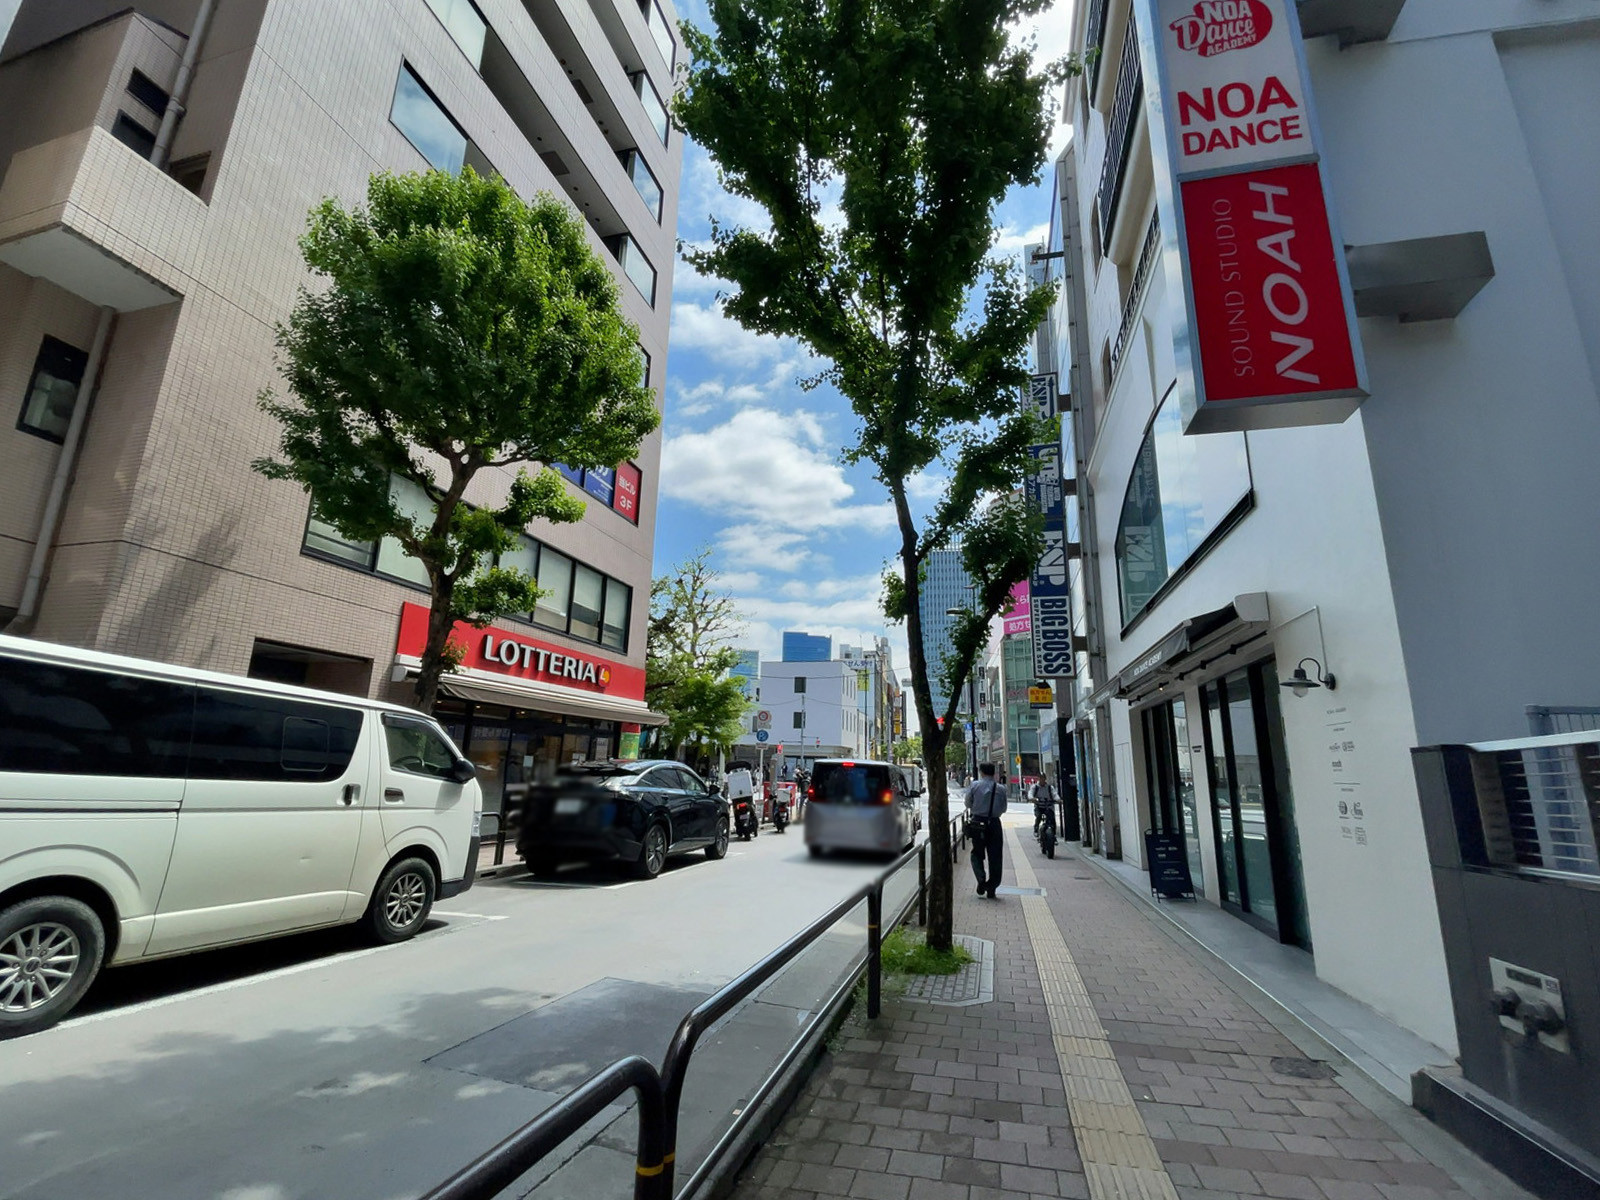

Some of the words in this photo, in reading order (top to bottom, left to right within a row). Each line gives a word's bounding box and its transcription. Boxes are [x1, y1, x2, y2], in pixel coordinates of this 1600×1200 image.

[1173, 15, 1255, 50] Dance
[1201, 0, 1253, 24] NOA
[1206, 33, 1257, 57] ACADEMY
[1177, 76, 1298, 126] NOA
[1181, 115, 1303, 156] DANCE
[1212, 198, 1242, 283] STUDIO
[1249, 181, 1321, 385] NOAH
[1223, 290, 1255, 378] SOUND
[618, 475, 636, 495] 当ビル
[619, 495, 633, 511] 3F
[1037, 530, 1066, 586] ESP
[1039, 598, 1069, 628] BIG
[484, 635, 596, 683] LOTTERIA
[1042, 628, 1072, 675] BOSS
